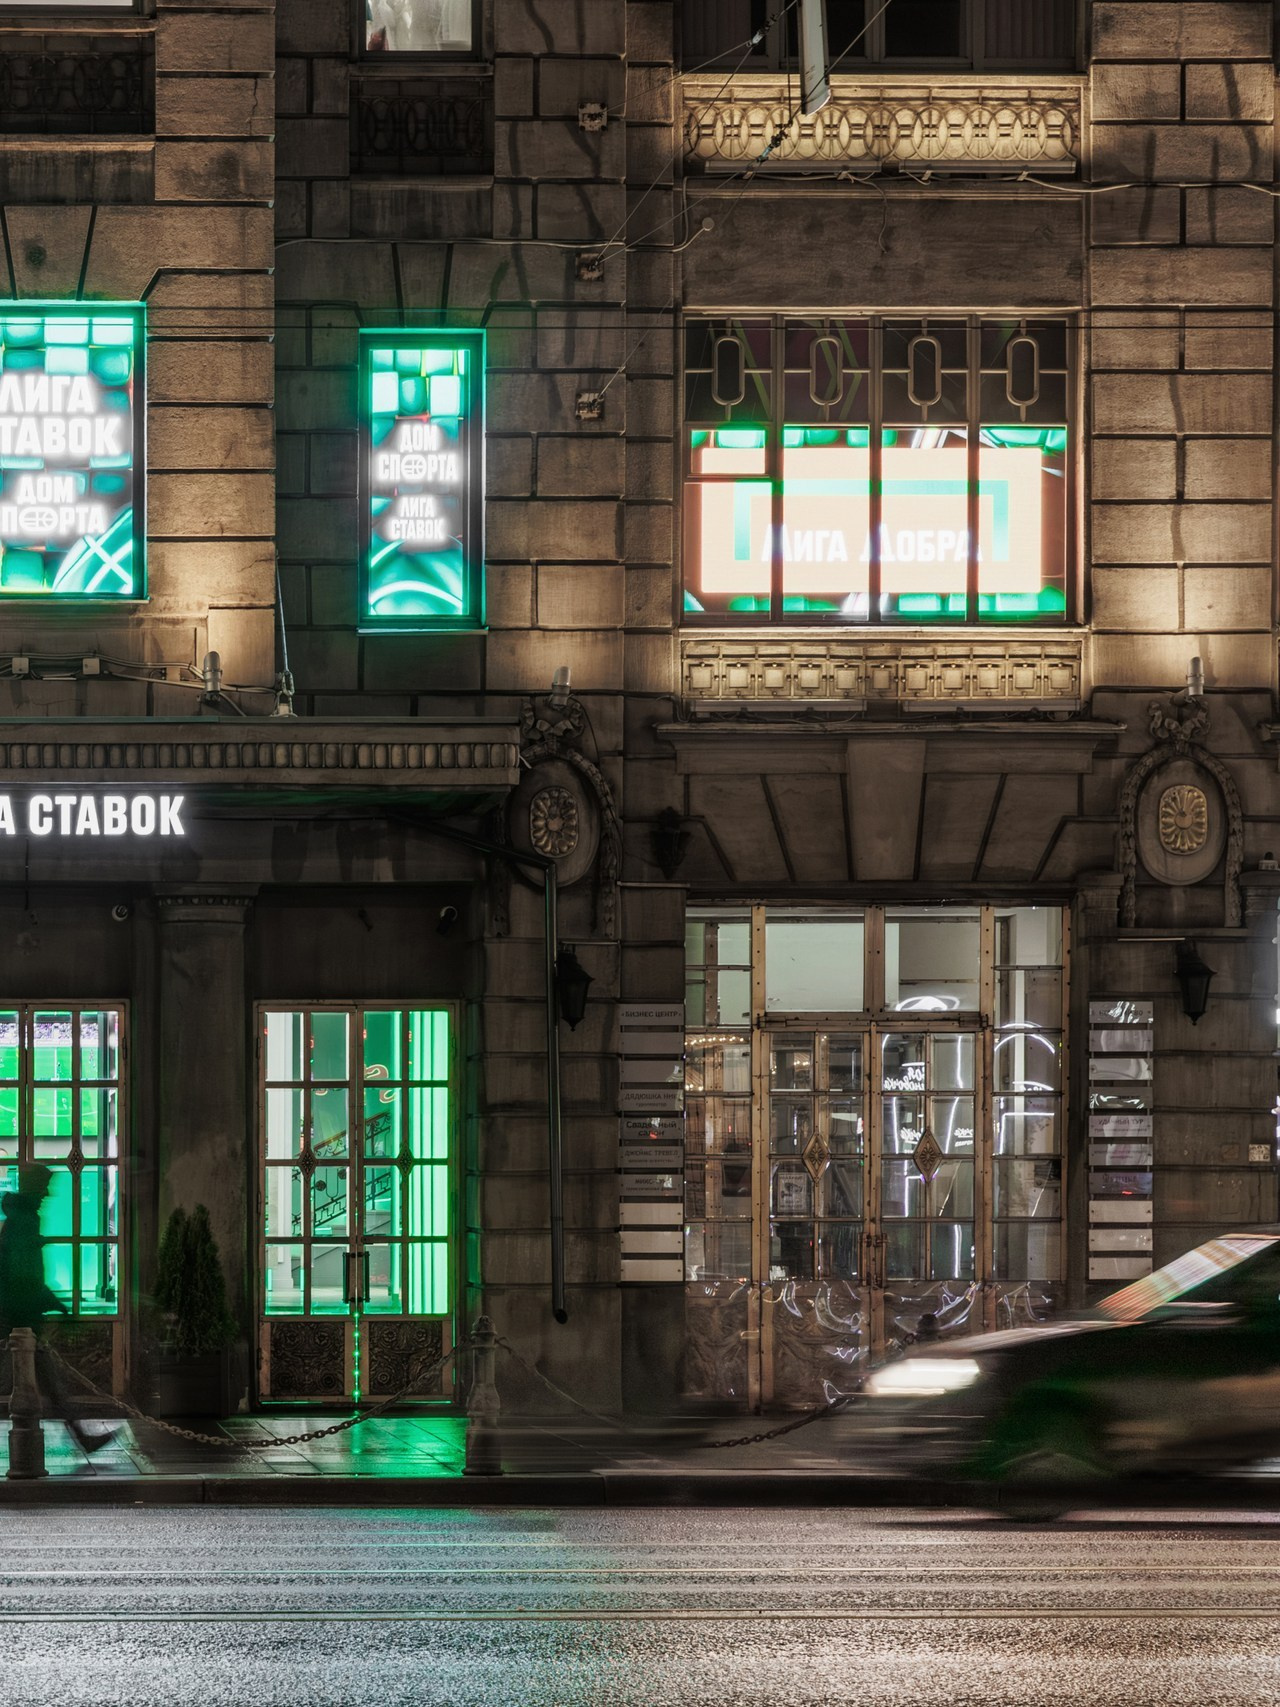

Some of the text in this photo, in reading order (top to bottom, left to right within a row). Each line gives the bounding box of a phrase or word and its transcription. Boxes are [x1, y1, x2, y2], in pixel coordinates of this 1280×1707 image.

[400, 424, 438, 452] ДОМ
[378, 453, 458, 480] СПОРТА
[17, 475, 75, 505] ДОМ
[400, 497, 435, 518] ЛИГА
[391, 518, 445, 541] СТАВОК
[28, 795, 185, 836] СТАВОК
[626, 1120, 677, 1129] Сваденый
